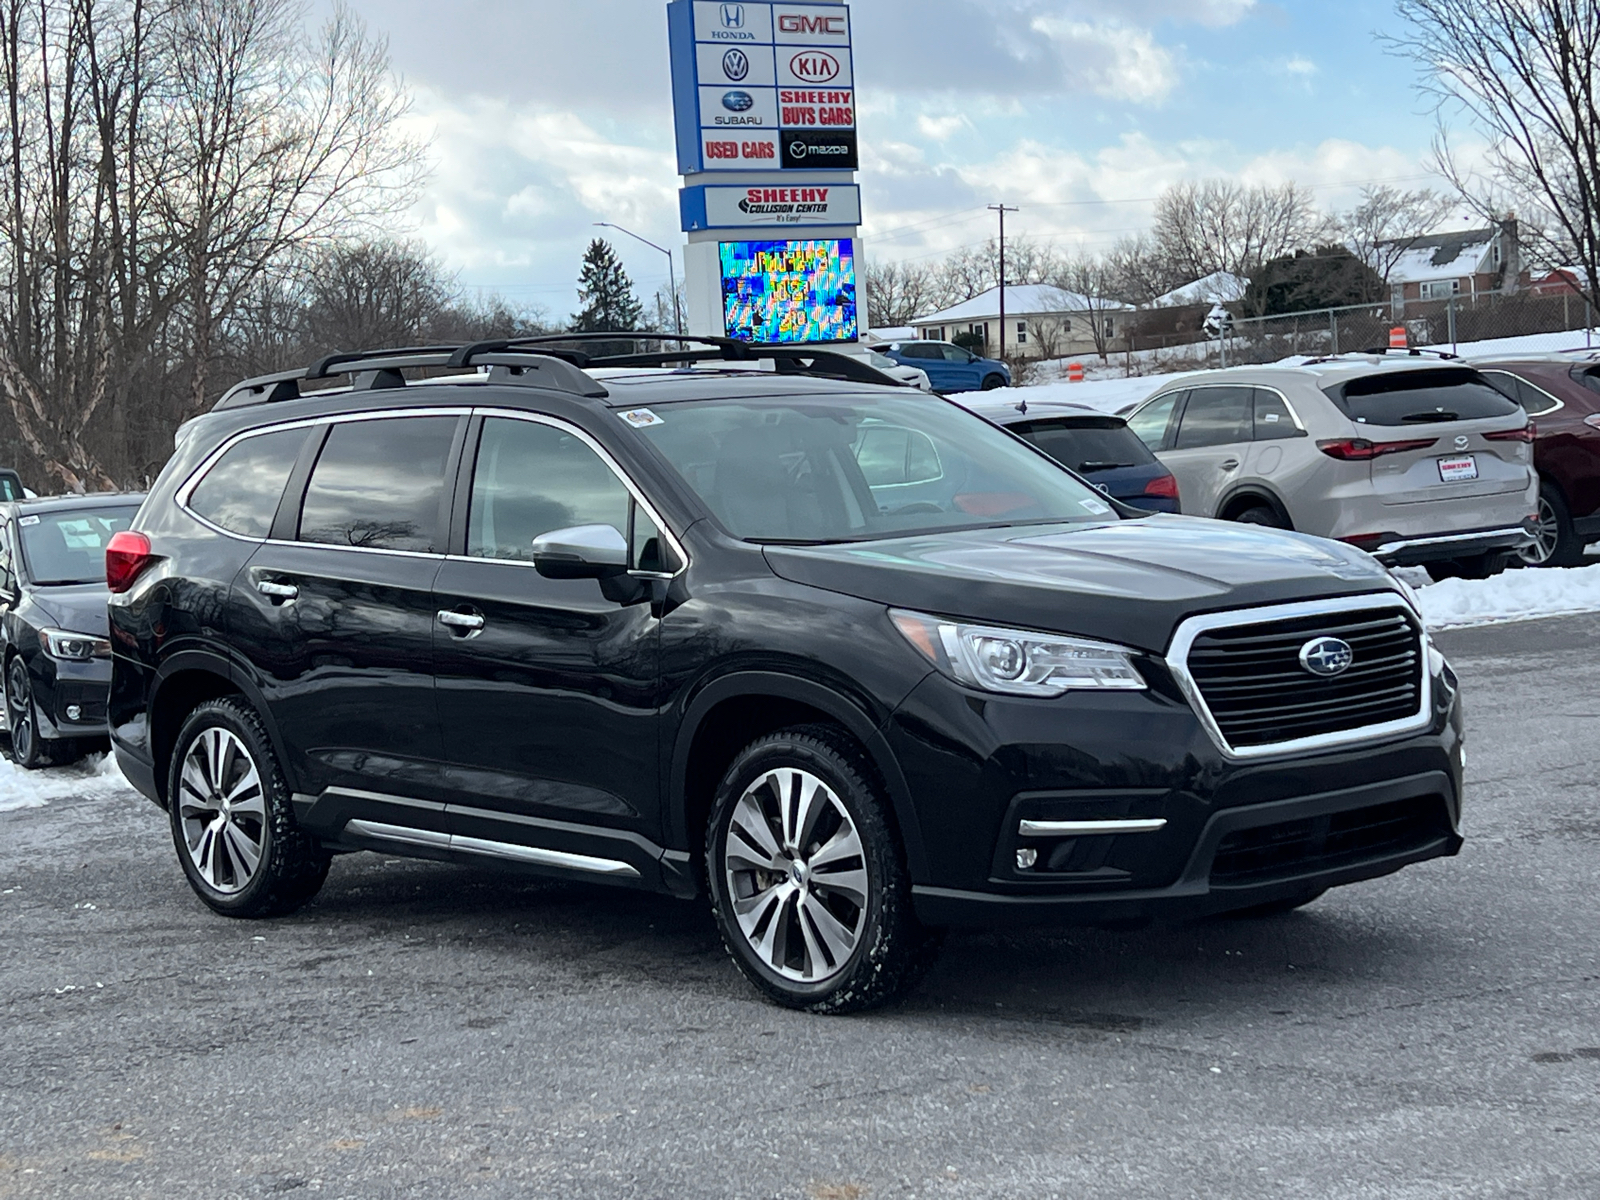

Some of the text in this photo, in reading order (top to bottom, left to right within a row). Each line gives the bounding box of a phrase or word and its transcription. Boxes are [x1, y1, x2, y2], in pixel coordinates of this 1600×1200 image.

[778, 14, 846, 35] GMC
[711, 31, 756, 40] HONDA
[798, 58, 832, 76] KIA
[780, 91, 852, 104] SHEEHY
[714, 116, 763, 125] SUBARU
[782, 107, 853, 126] BUYS CARS
[705, 141, 775, 159] USED CARS
[747, 188, 829, 203] SHEEHY
[749, 203, 828, 214] COLLISION CENTER
